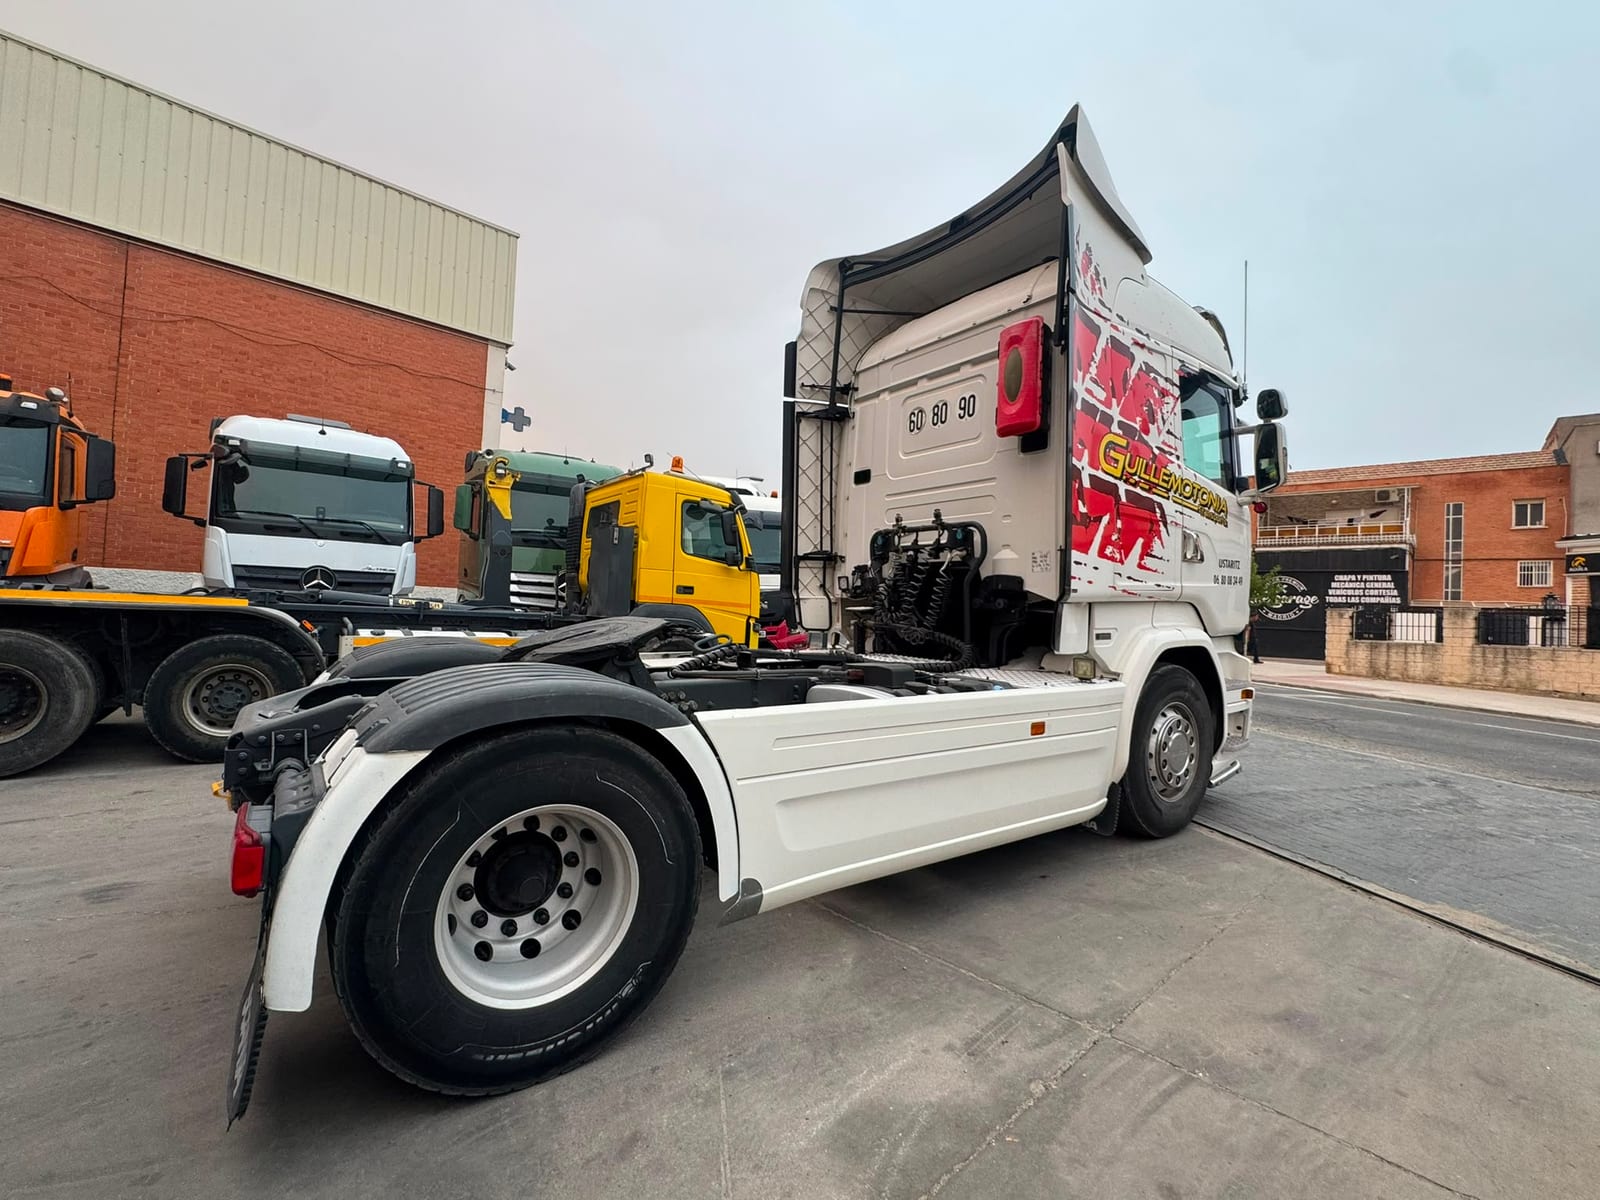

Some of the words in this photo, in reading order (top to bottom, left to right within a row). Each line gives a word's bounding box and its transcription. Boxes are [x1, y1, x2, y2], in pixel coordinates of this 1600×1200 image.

[908, 409, 923, 433] 60
[931, 401, 948, 427] 80
[958, 394, 976, 420] 90
[1365, 581, 1395, 589] GENERAL
